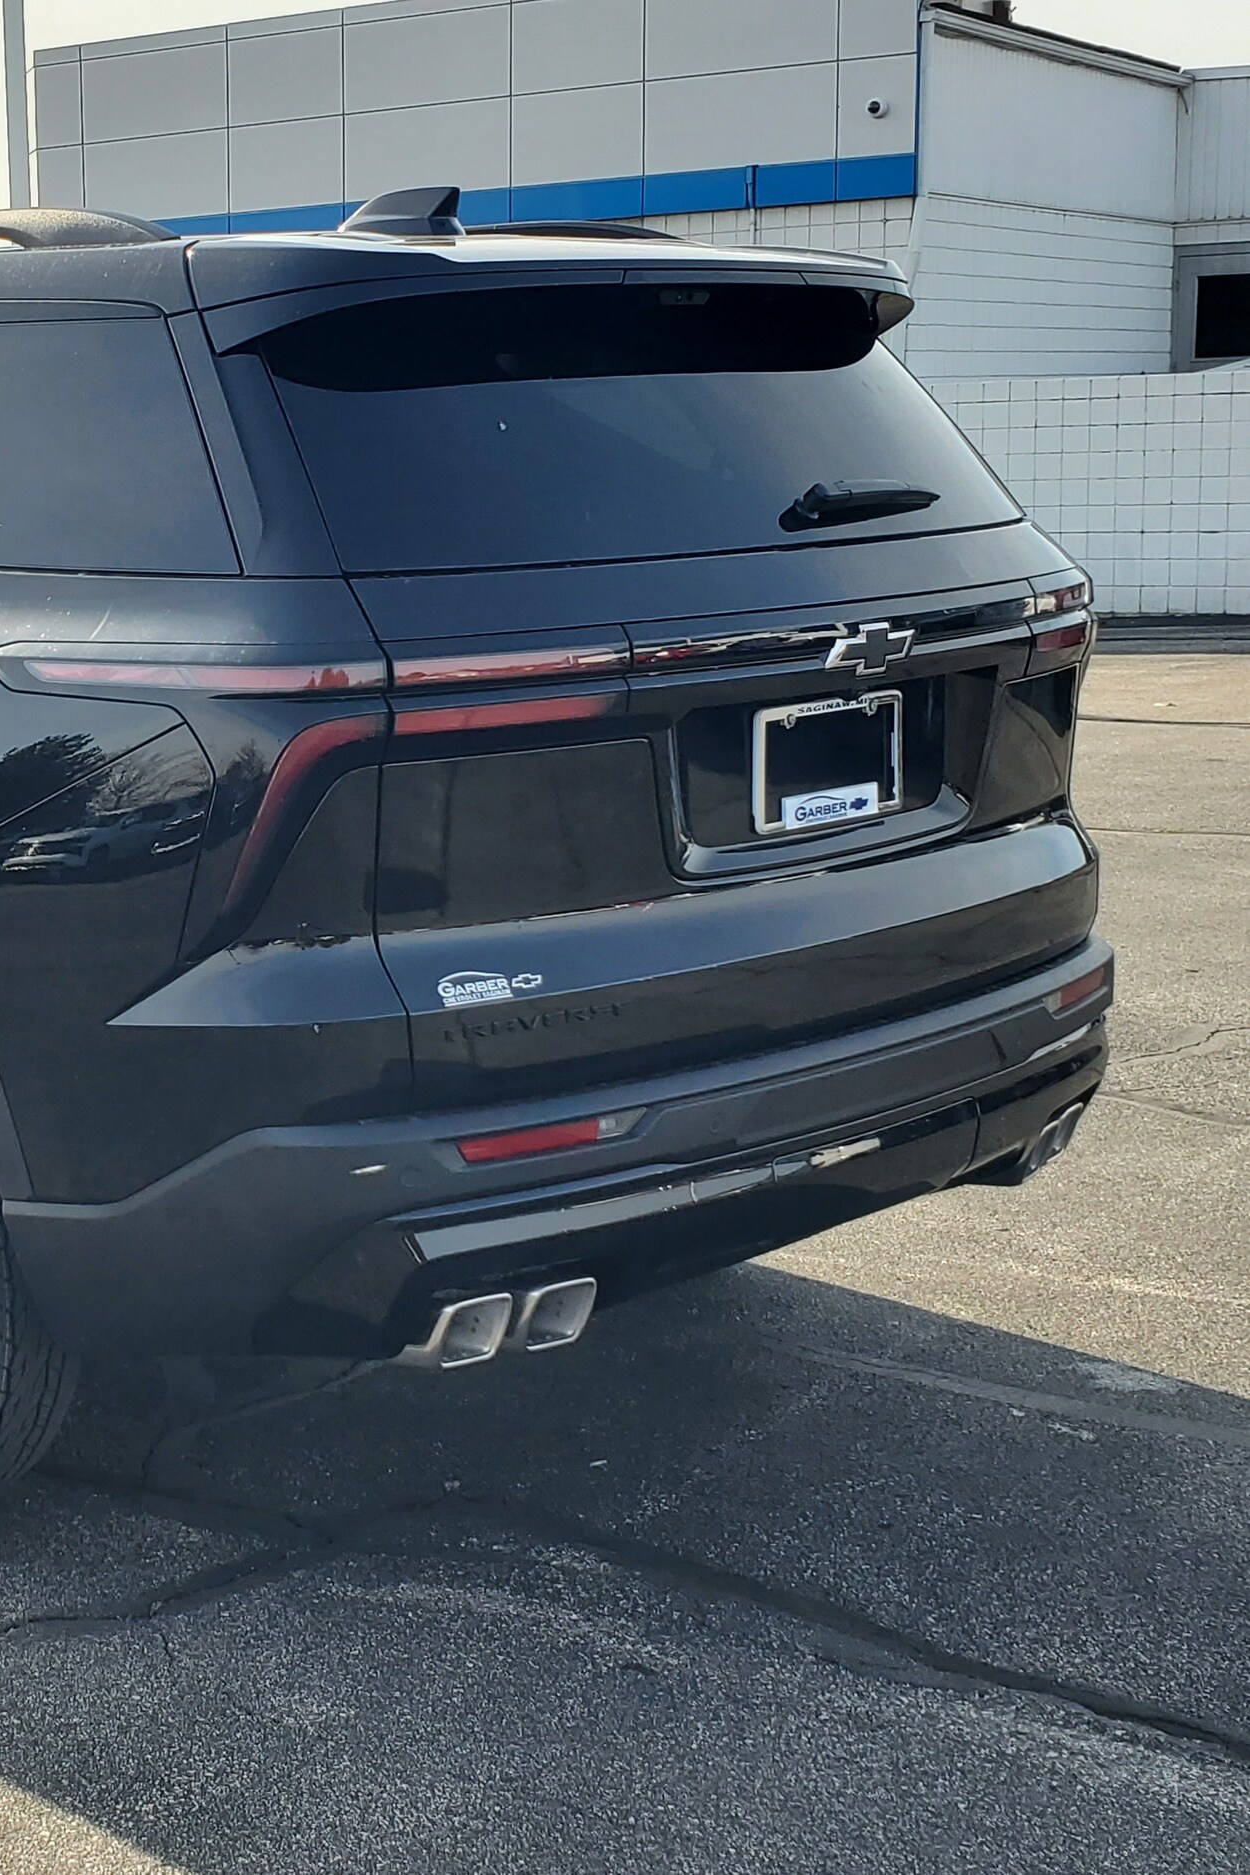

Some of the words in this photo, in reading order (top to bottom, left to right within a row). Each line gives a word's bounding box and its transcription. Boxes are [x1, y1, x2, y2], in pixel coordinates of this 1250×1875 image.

[795, 801, 848, 822] GARBER
[437, 978, 510, 997] GARBER
[442, 1003, 631, 1043] TRAVERSE
